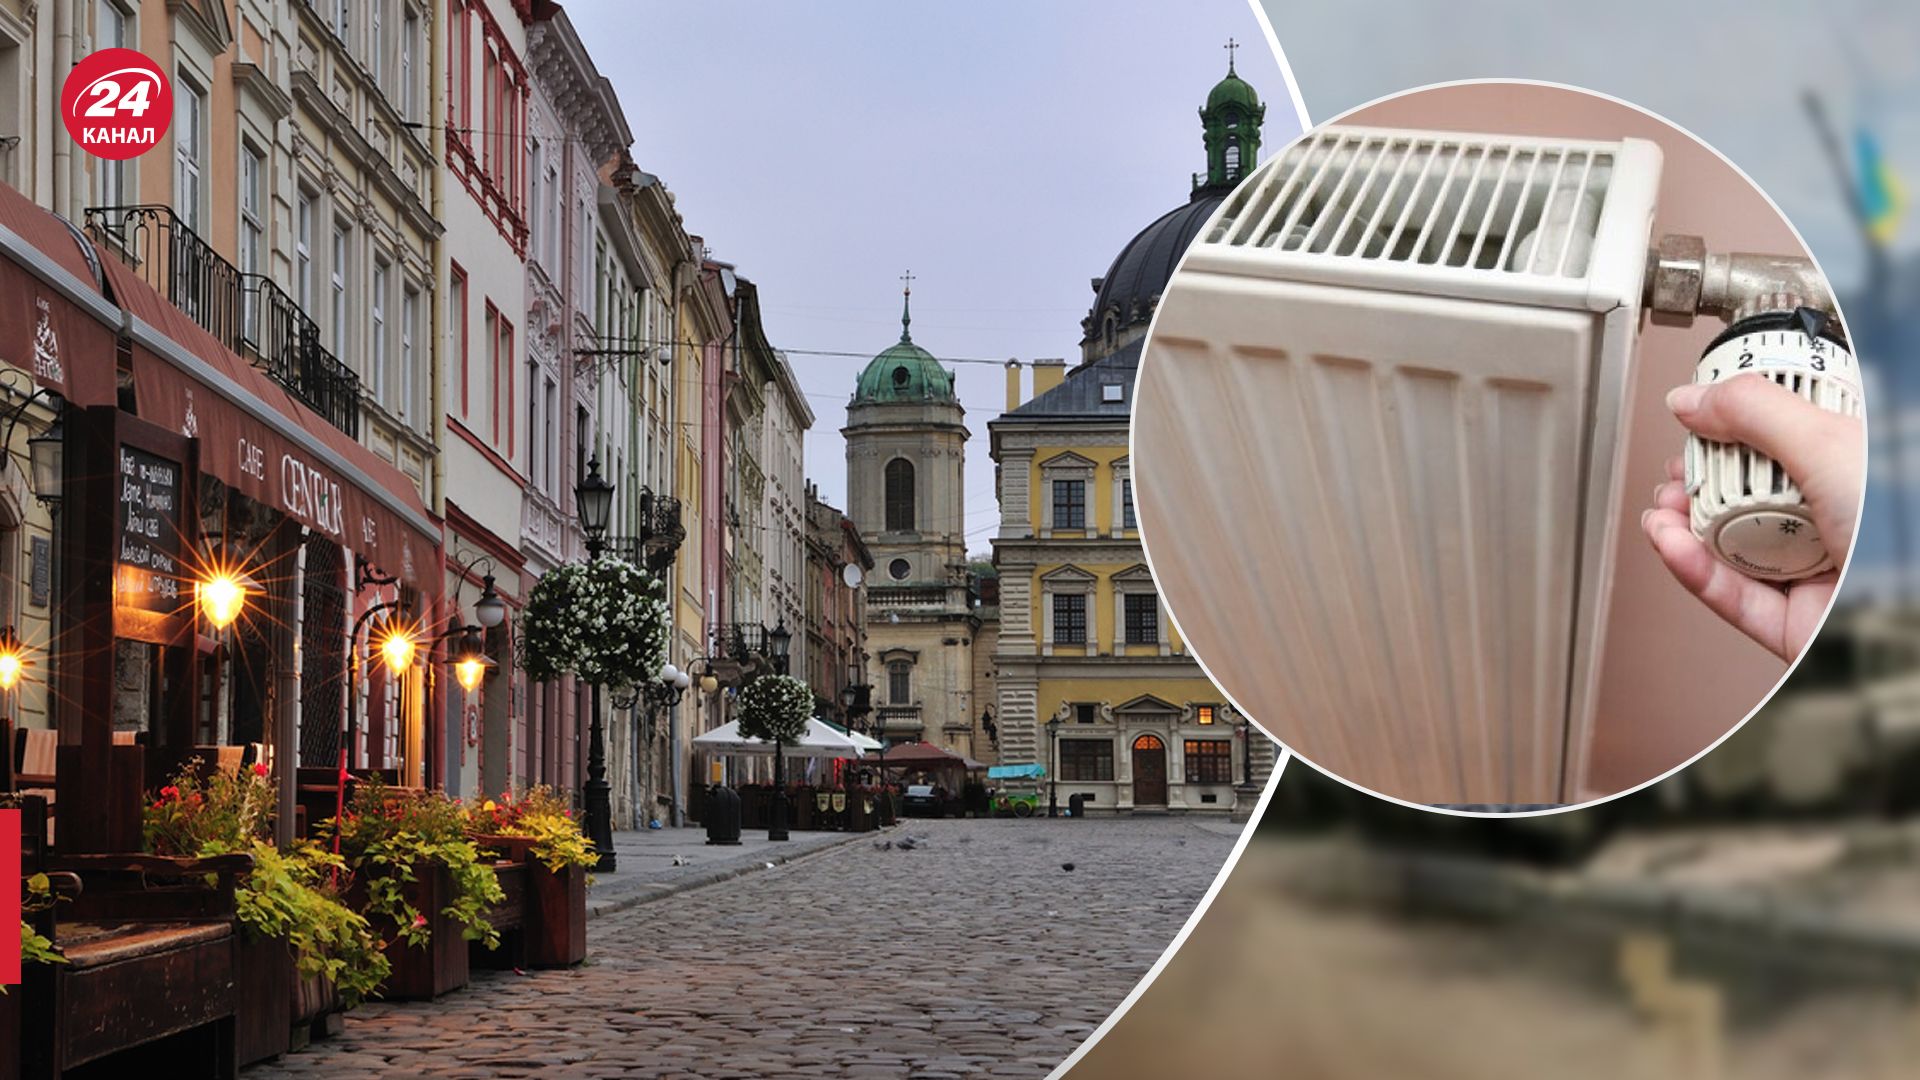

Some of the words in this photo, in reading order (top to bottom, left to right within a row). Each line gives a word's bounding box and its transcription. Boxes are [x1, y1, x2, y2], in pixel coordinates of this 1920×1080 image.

[1738, 352, 1753, 369] 2
[1810, 355, 1825, 371] 3
[238, 438, 264, 480] CAFE
